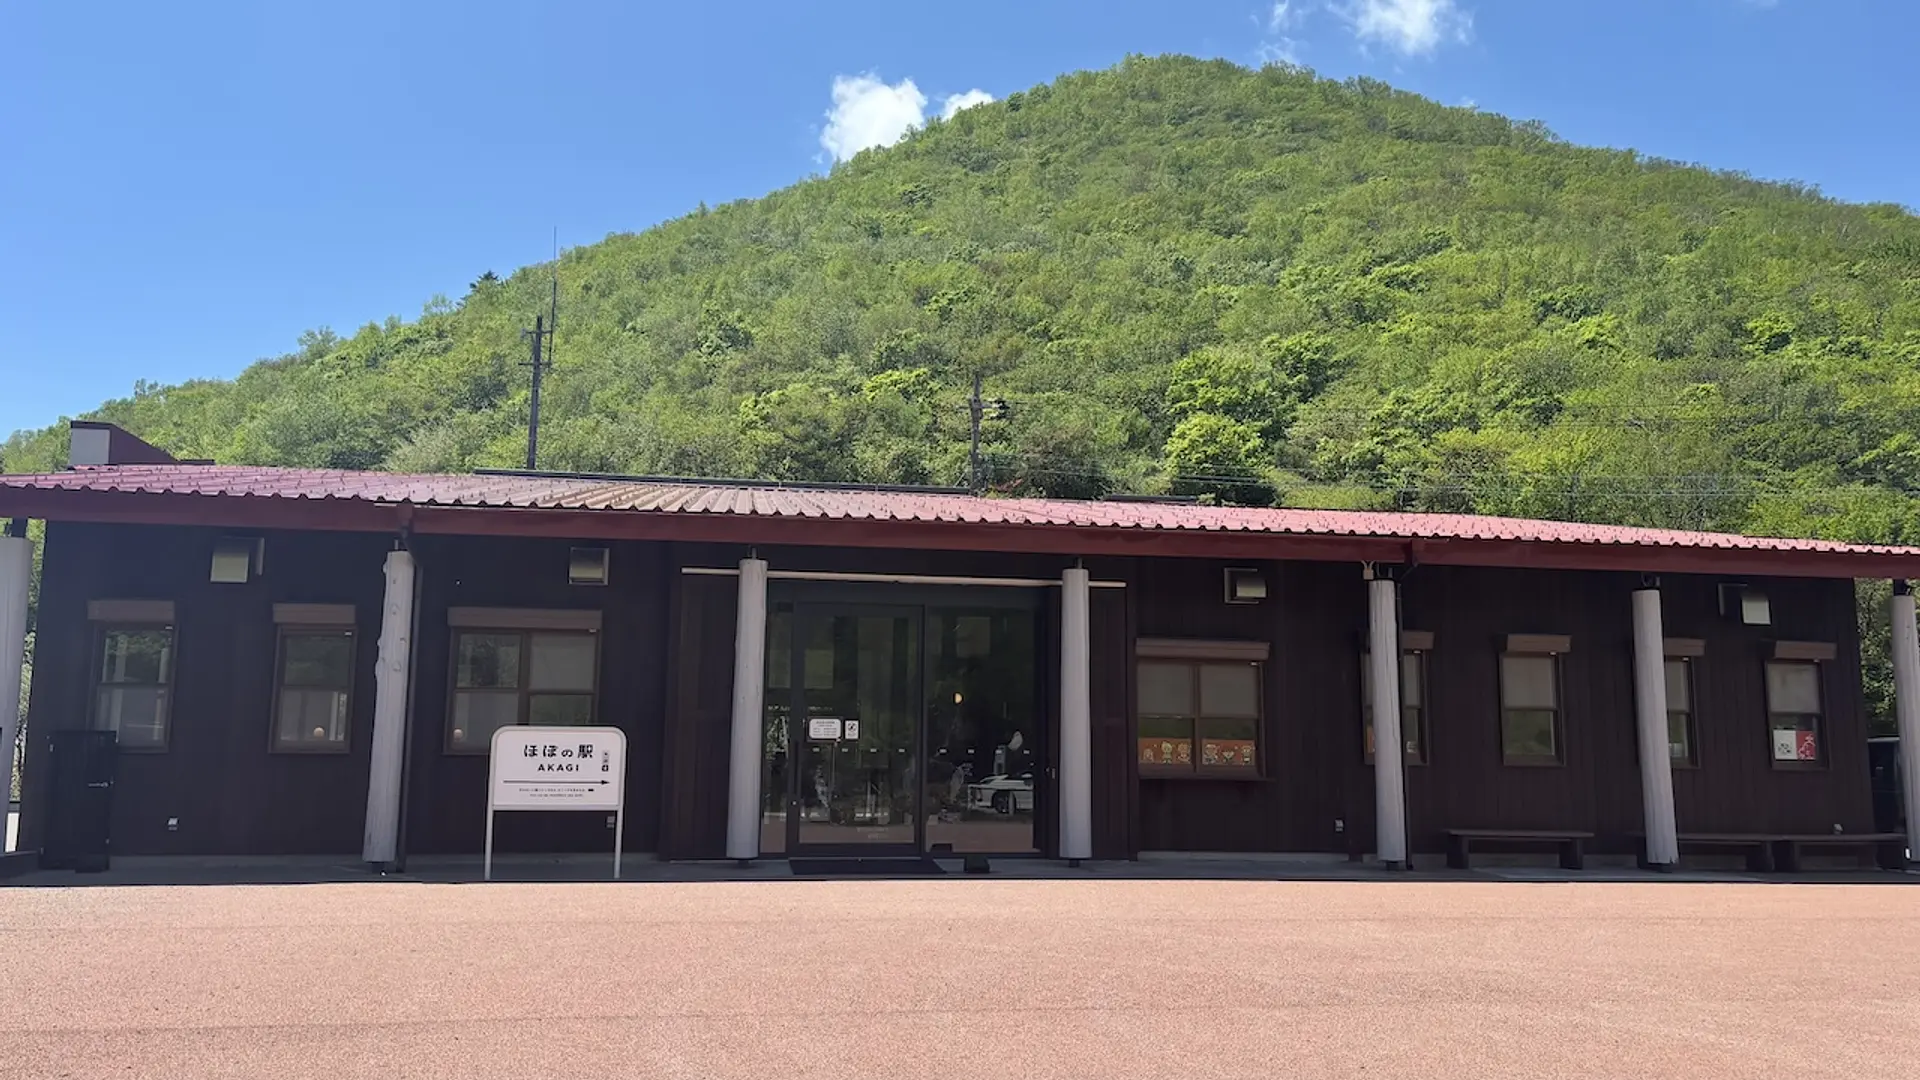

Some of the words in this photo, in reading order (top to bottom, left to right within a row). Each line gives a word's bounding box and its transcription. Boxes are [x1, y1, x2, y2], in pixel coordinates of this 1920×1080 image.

[524, 744, 594, 759] ほぼの駅
[538, 763, 579, 772] AKAGI
